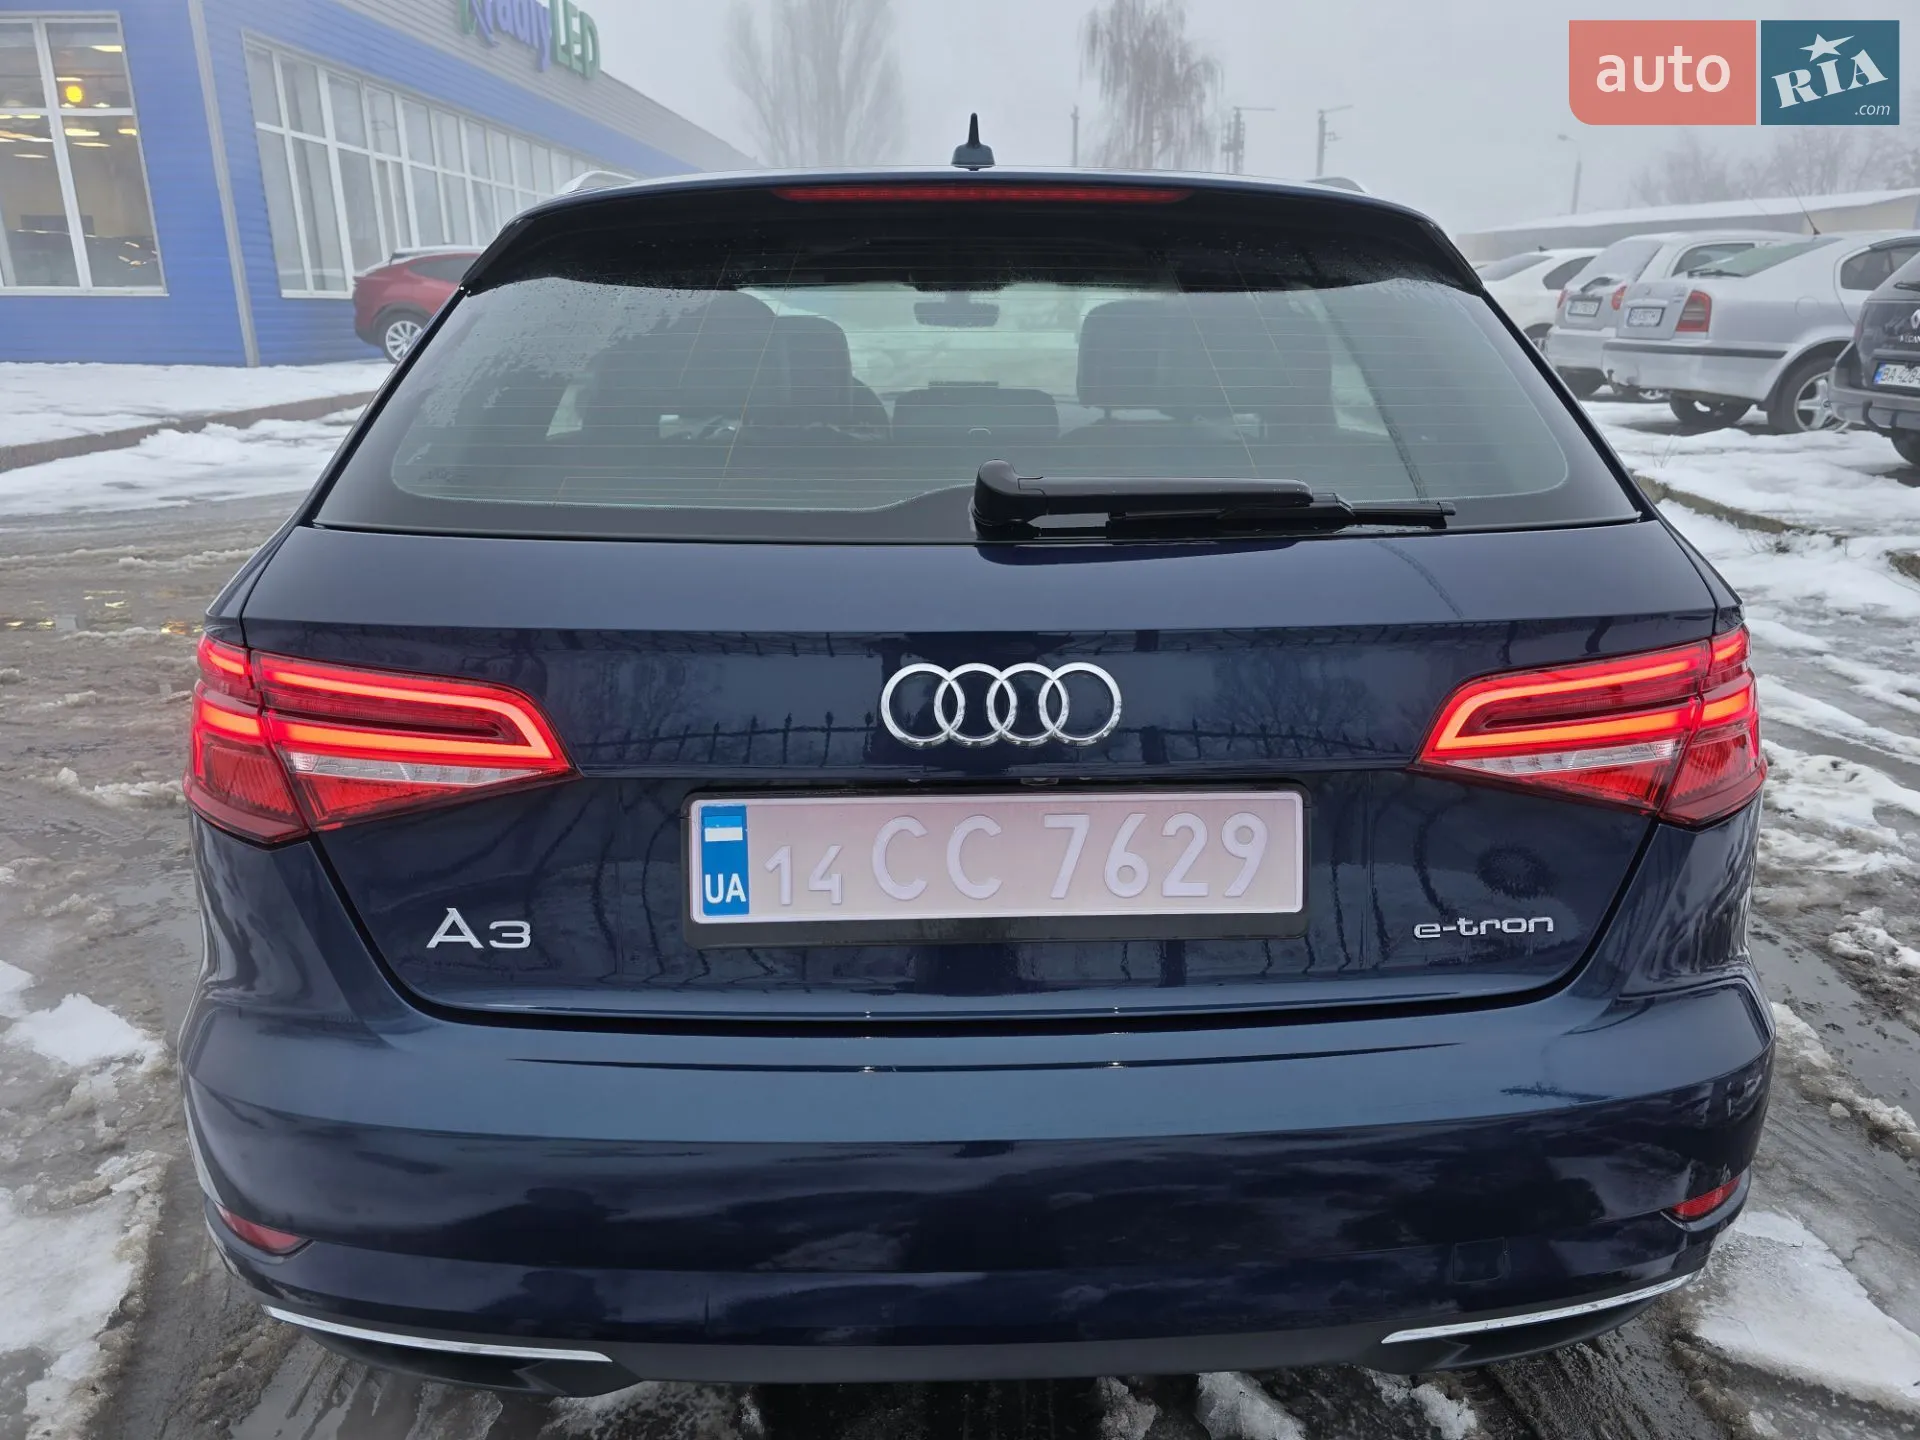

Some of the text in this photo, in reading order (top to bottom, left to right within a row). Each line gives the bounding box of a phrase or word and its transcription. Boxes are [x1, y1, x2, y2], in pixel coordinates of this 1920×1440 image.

[764, 812, 1268, 906] 14 CC 7629
[704, 873, 747, 904] UA
[426, 907, 532, 949] A3
[1413, 917, 1555, 939] e-tron
